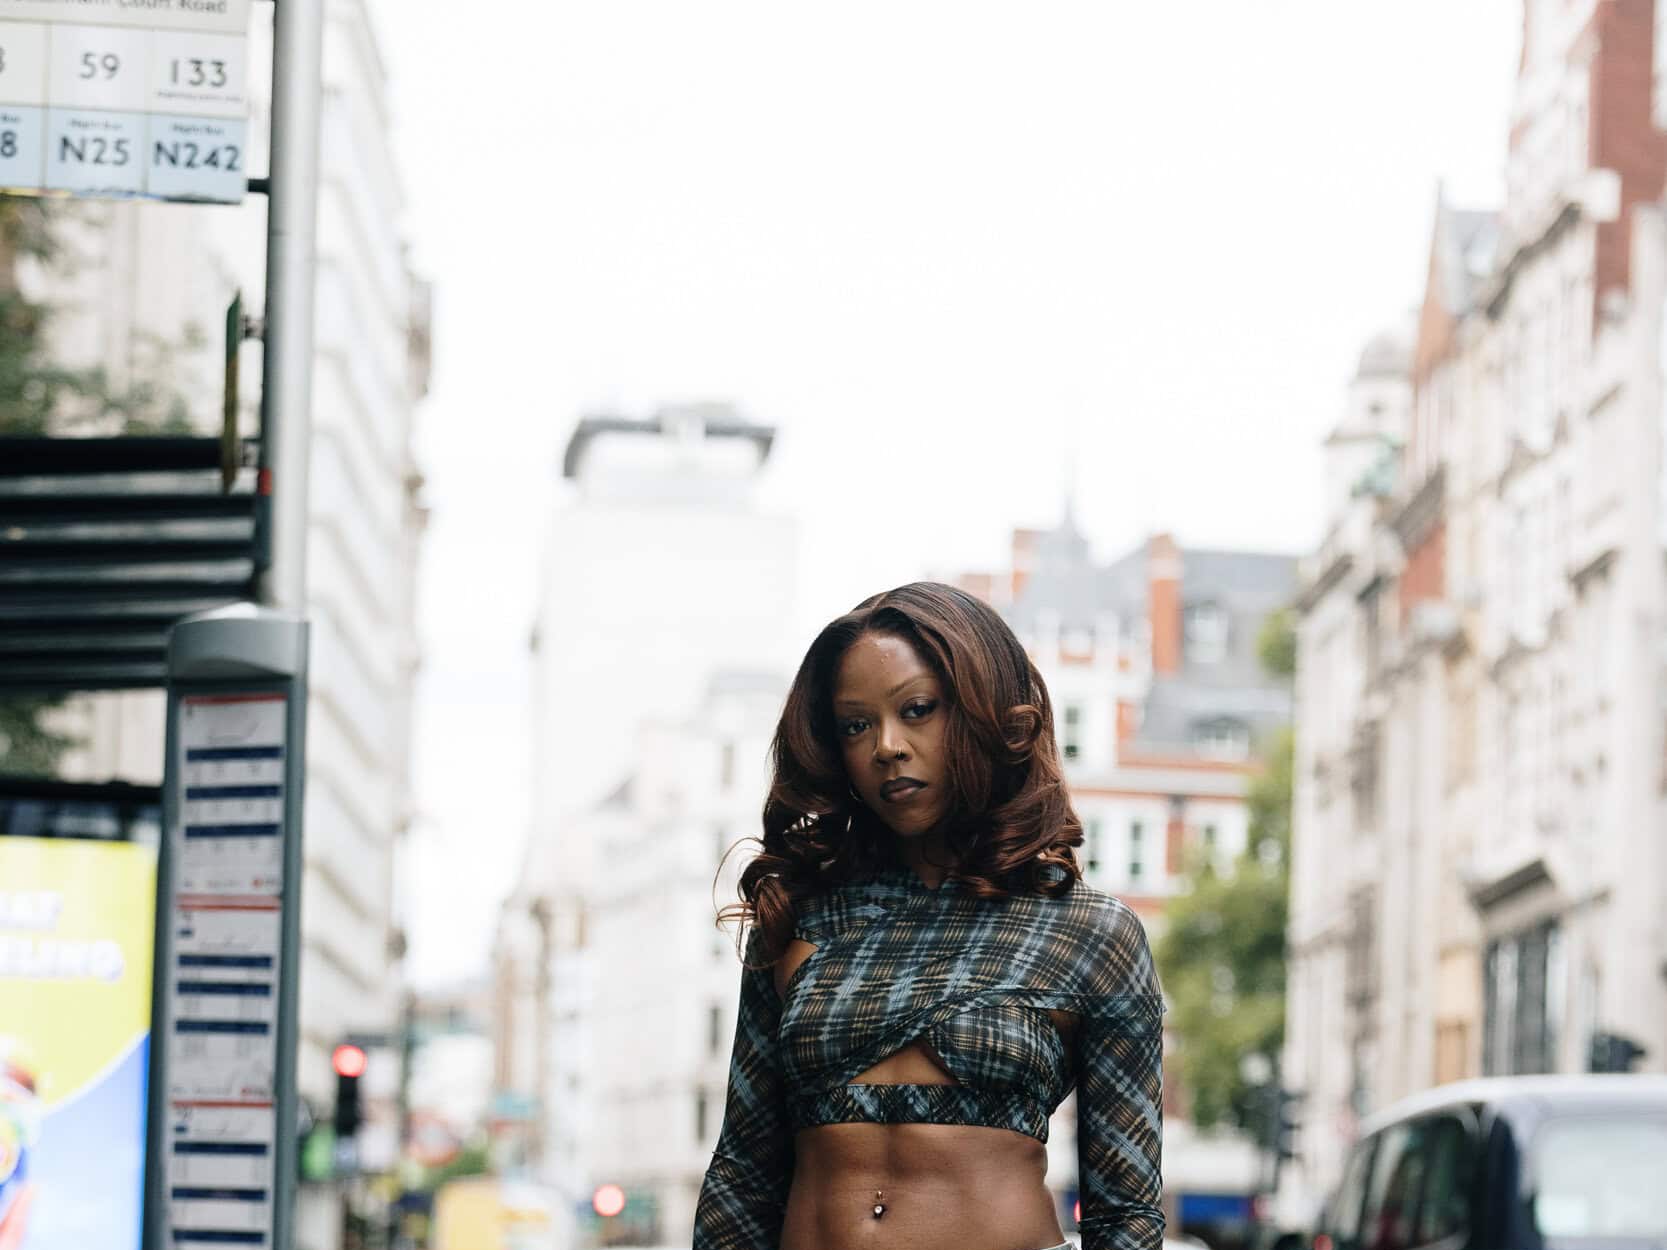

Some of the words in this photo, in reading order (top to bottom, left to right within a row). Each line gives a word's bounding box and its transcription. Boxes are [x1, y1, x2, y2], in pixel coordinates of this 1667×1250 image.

[80, 52, 120, 79] 59
[171, 59, 228, 88] 133
[59, 136, 129, 166] N25
[154, 141, 240, 172] N242
